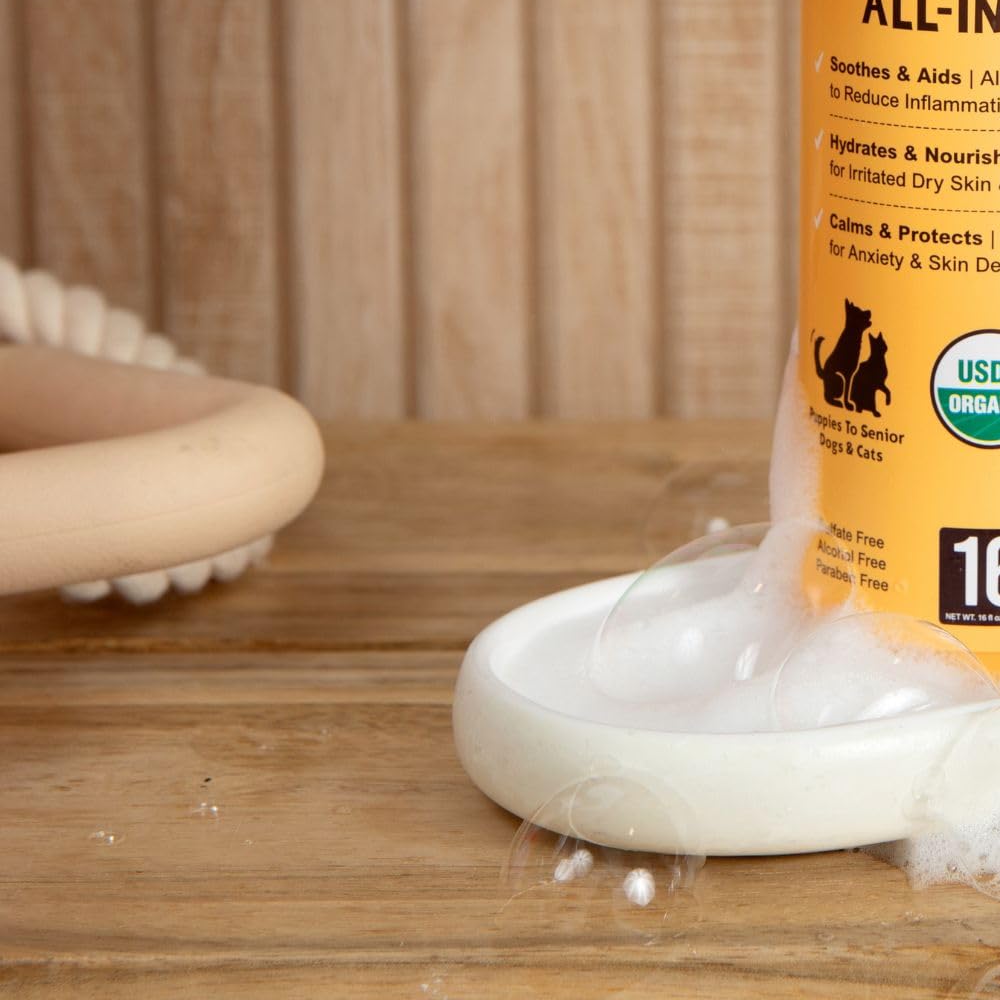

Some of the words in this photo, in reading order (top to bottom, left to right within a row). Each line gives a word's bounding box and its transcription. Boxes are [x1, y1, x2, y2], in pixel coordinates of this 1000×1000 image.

[830, 56, 890, 80] Soothes
[897, 66, 910, 82] &
[917, 68, 962, 84] Aids
[829, 83, 840, 99] to
[844, 86, 899, 108] Reduce
[830, 133, 897, 159] Hydrates
[904, 145, 917, 161] &
[829, 160, 845, 178] for
[849, 164, 906, 187] Irritated
[912, 172, 944, 194] Dry
[950, 175, 991, 192] Skin
[830, 213, 873, 237] Calms
[879, 223, 891, 239] &
[899, 225, 983, 246] Protects
[829, 240, 844, 257] for
[848, 244, 904, 271] Anxiety
[910, 253, 922, 270] &
[929, 254, 968, 273] Skin
[810, 406, 842, 432] Pppies
[845, 420, 857, 436] To
[861, 424, 904, 444] Senior
[820, 432, 844, 455] Dogs
[846, 441, 853, 455] &
[857, 444, 883, 462] Cats
[856, 530, 884, 549] Free
[858, 552, 886, 570] Free
[860, 573, 889, 592] Free
[945, 612, 961, 620] NET
[978, 614, 987, 622] 16
